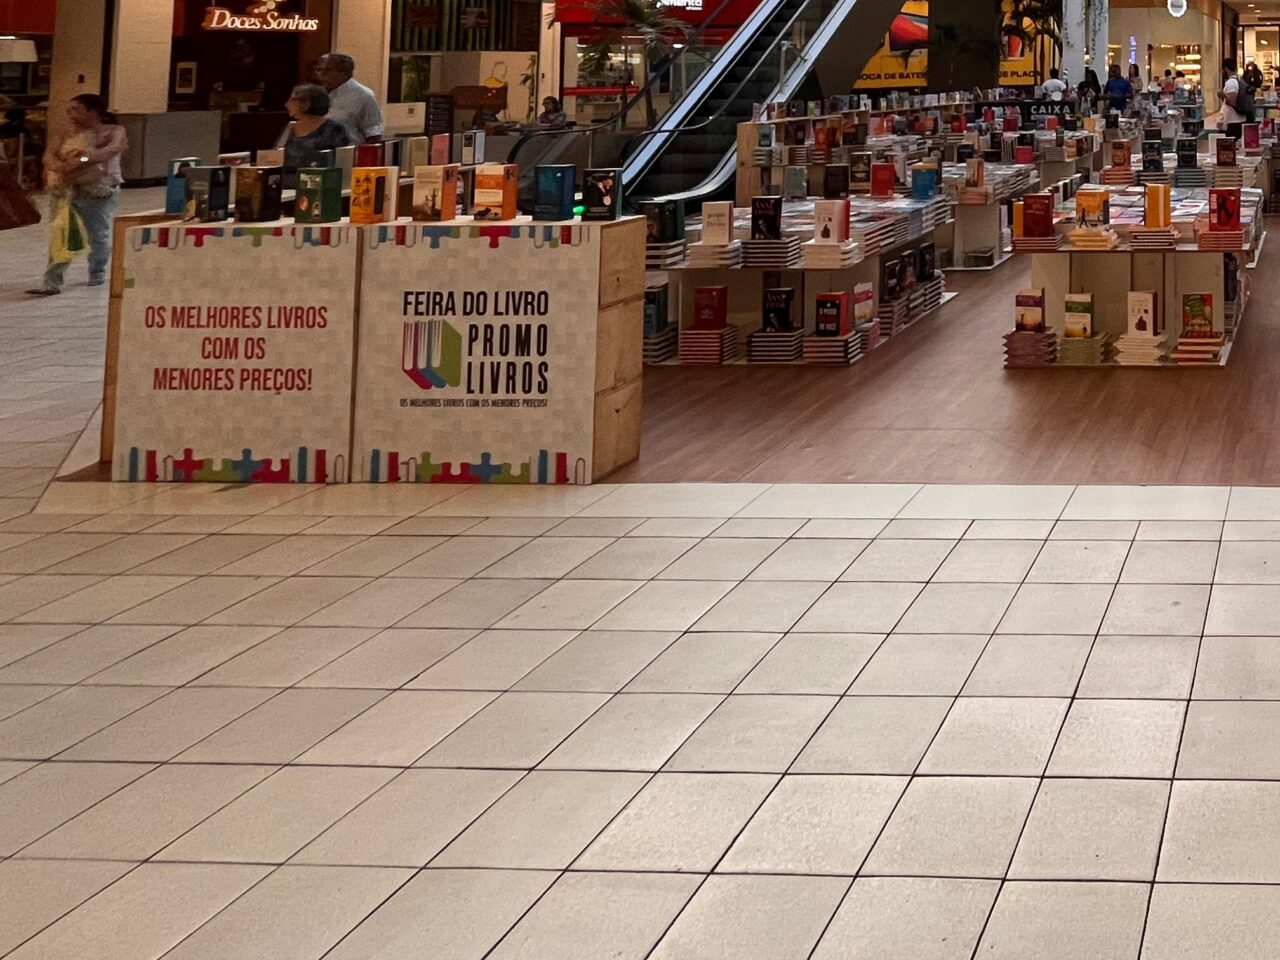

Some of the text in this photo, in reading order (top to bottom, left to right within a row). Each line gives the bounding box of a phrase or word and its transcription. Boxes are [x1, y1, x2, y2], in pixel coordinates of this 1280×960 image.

[210, 10, 319, 30] Doces Sonhos
[1030, 105, 1071, 114] CAIXA
[403, 290, 549, 316] FEIRA DO LIVRO
[144, 305, 328, 329] OS MELHORES LIVROS
[201, 336, 266, 360] COM OS
[467, 323, 548, 357] PROMO
[153, 367, 313, 396] MENORES PREÇOS!
[466, 361, 549, 394] LIVROS
